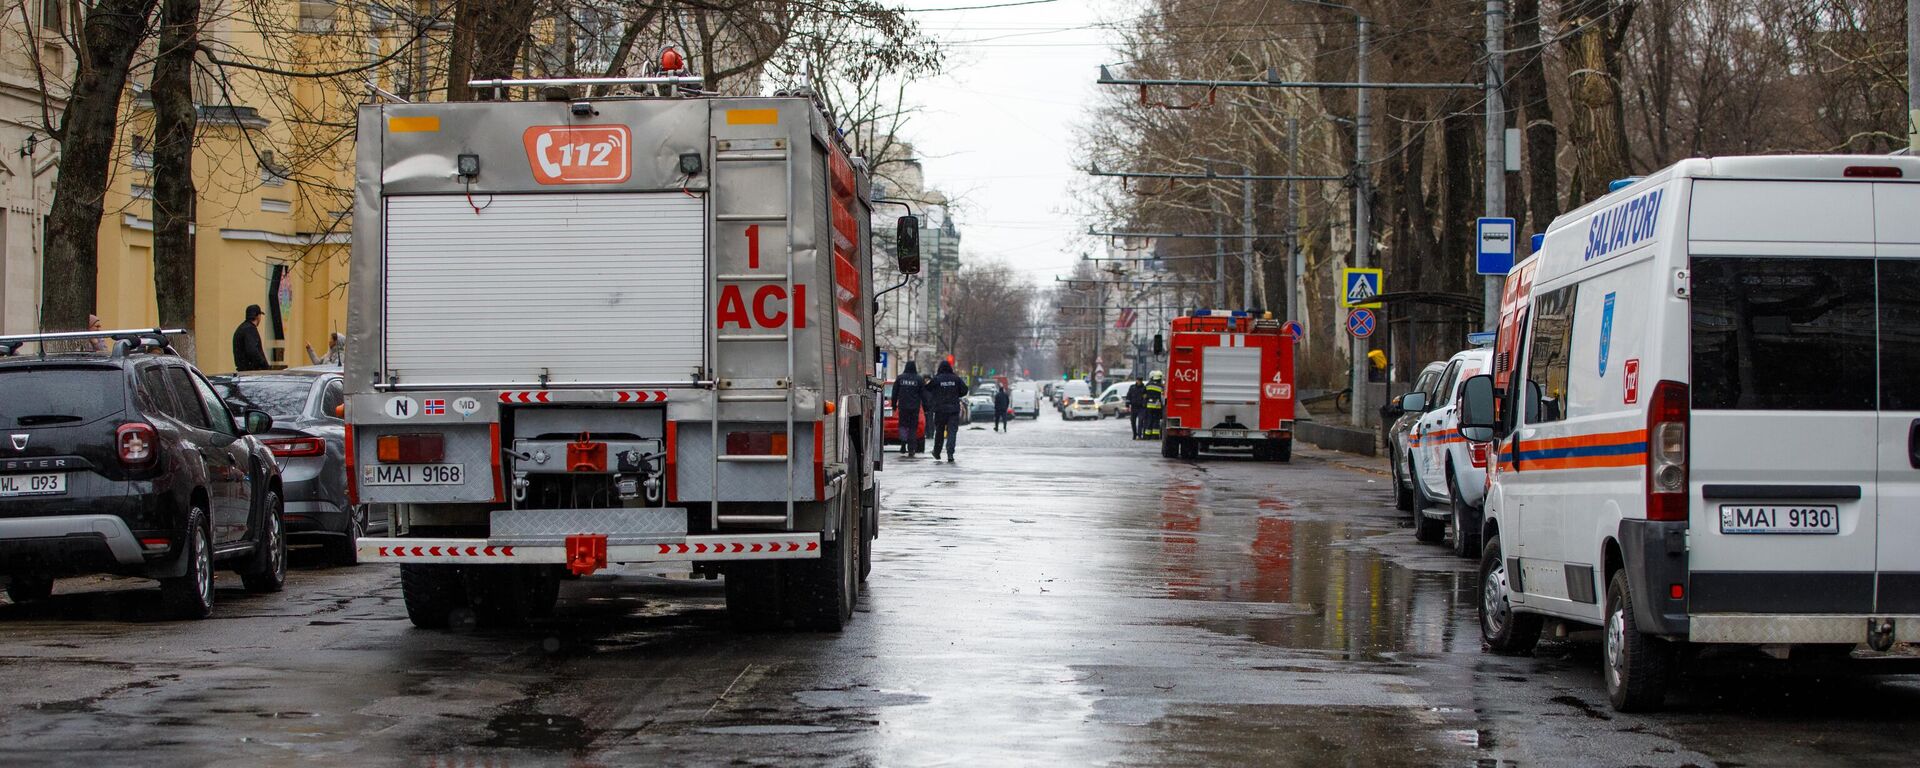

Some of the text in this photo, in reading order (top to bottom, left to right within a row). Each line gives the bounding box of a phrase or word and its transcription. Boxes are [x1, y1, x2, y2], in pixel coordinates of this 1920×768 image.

[558, 143, 613, 167] 112
[1584, 188, 1664, 262] SALVATORI
[744, 224, 760, 269] 1
[716, 284, 806, 329] ACI
[1175, 369, 1198, 382] ACI
[1272, 371, 1282, 384] 4
[396, 400, 408, 416] N
[459, 400, 475, 410] MD
[31, 475, 58, 490] 093
[377, 466, 460, 483] MAI 9168
[1736, 508, 1831, 528] MAI 9130
